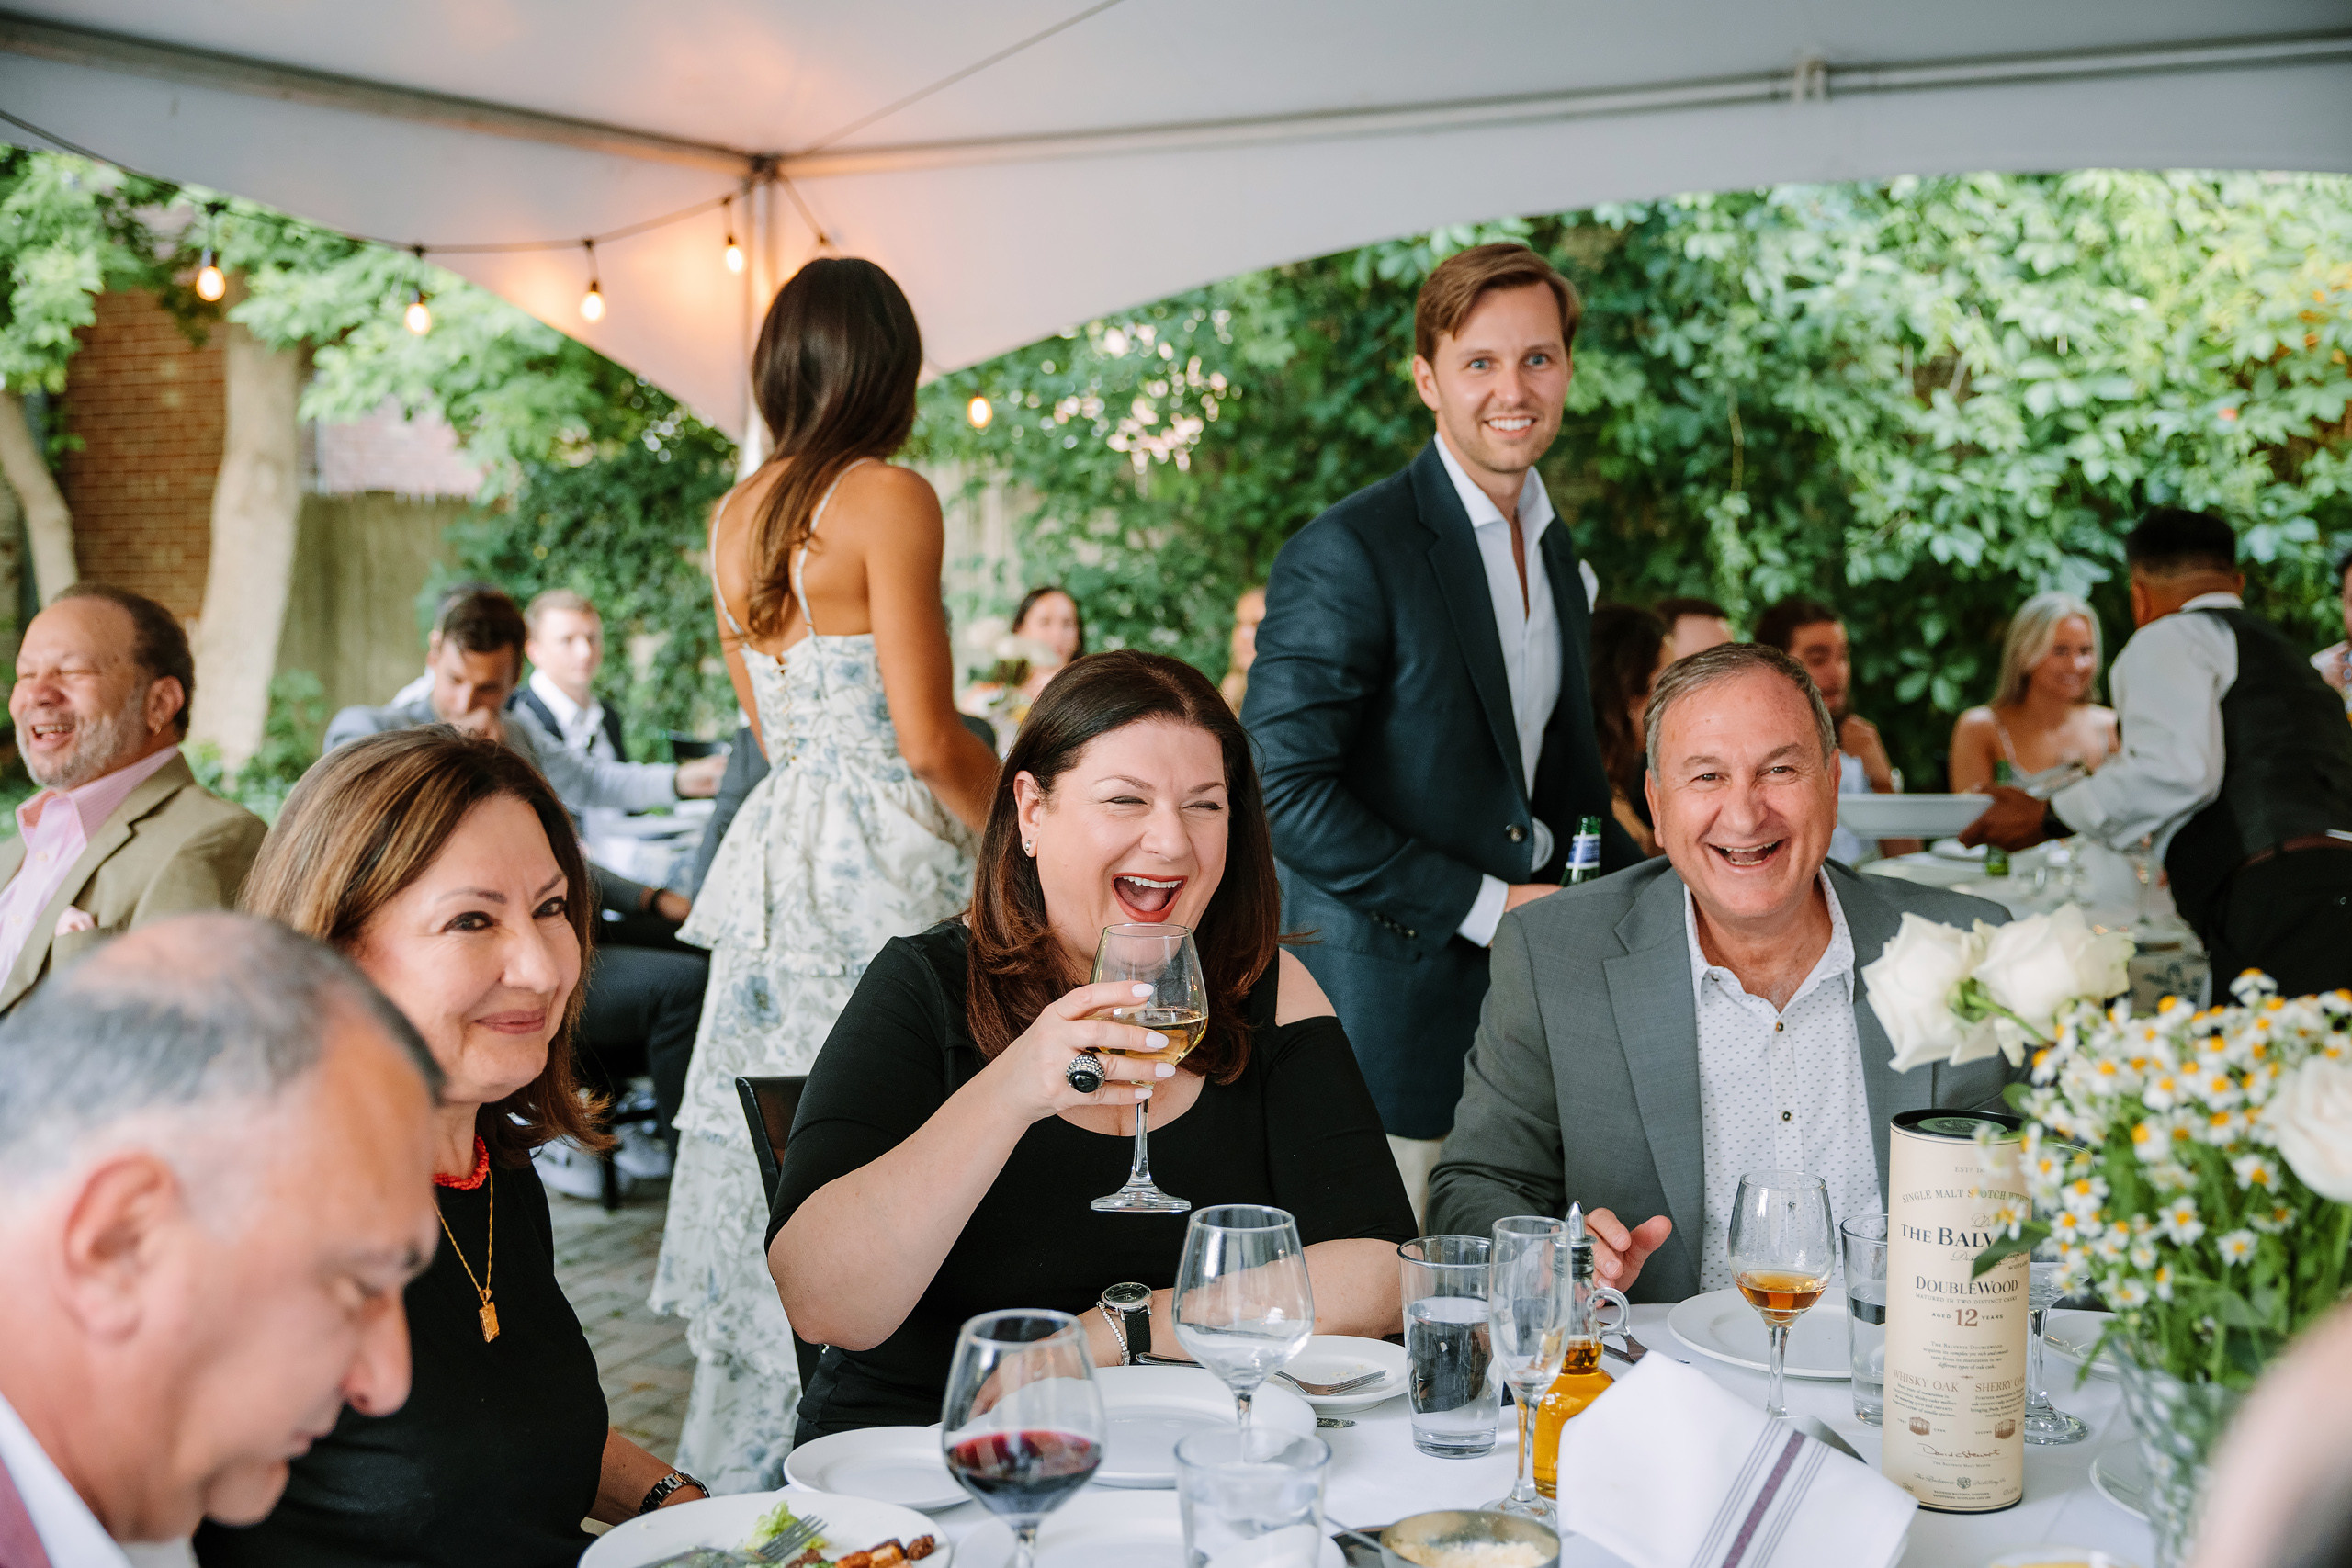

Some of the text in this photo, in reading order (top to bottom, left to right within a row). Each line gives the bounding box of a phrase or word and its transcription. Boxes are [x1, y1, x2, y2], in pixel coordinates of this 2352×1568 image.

[1902, 1190, 1932, 1204] SINGLE
[1935, 1189, 1964, 1199] MALT
[1967, 1188, 2007, 1201] SOTCH
[1901, 1223, 1993, 1247] THE BALV
[1916, 1275, 2019, 1296] DOUBLEWOOD
[1916, 1292, 1944, 1303] MATURED
[1955, 1308, 1979, 1327] 12
[1894, 1369, 1928, 1387] WHISKY
[1932, 1380, 1959, 1393] OAK
[1975, 1379, 2013, 1393] SHERRY
